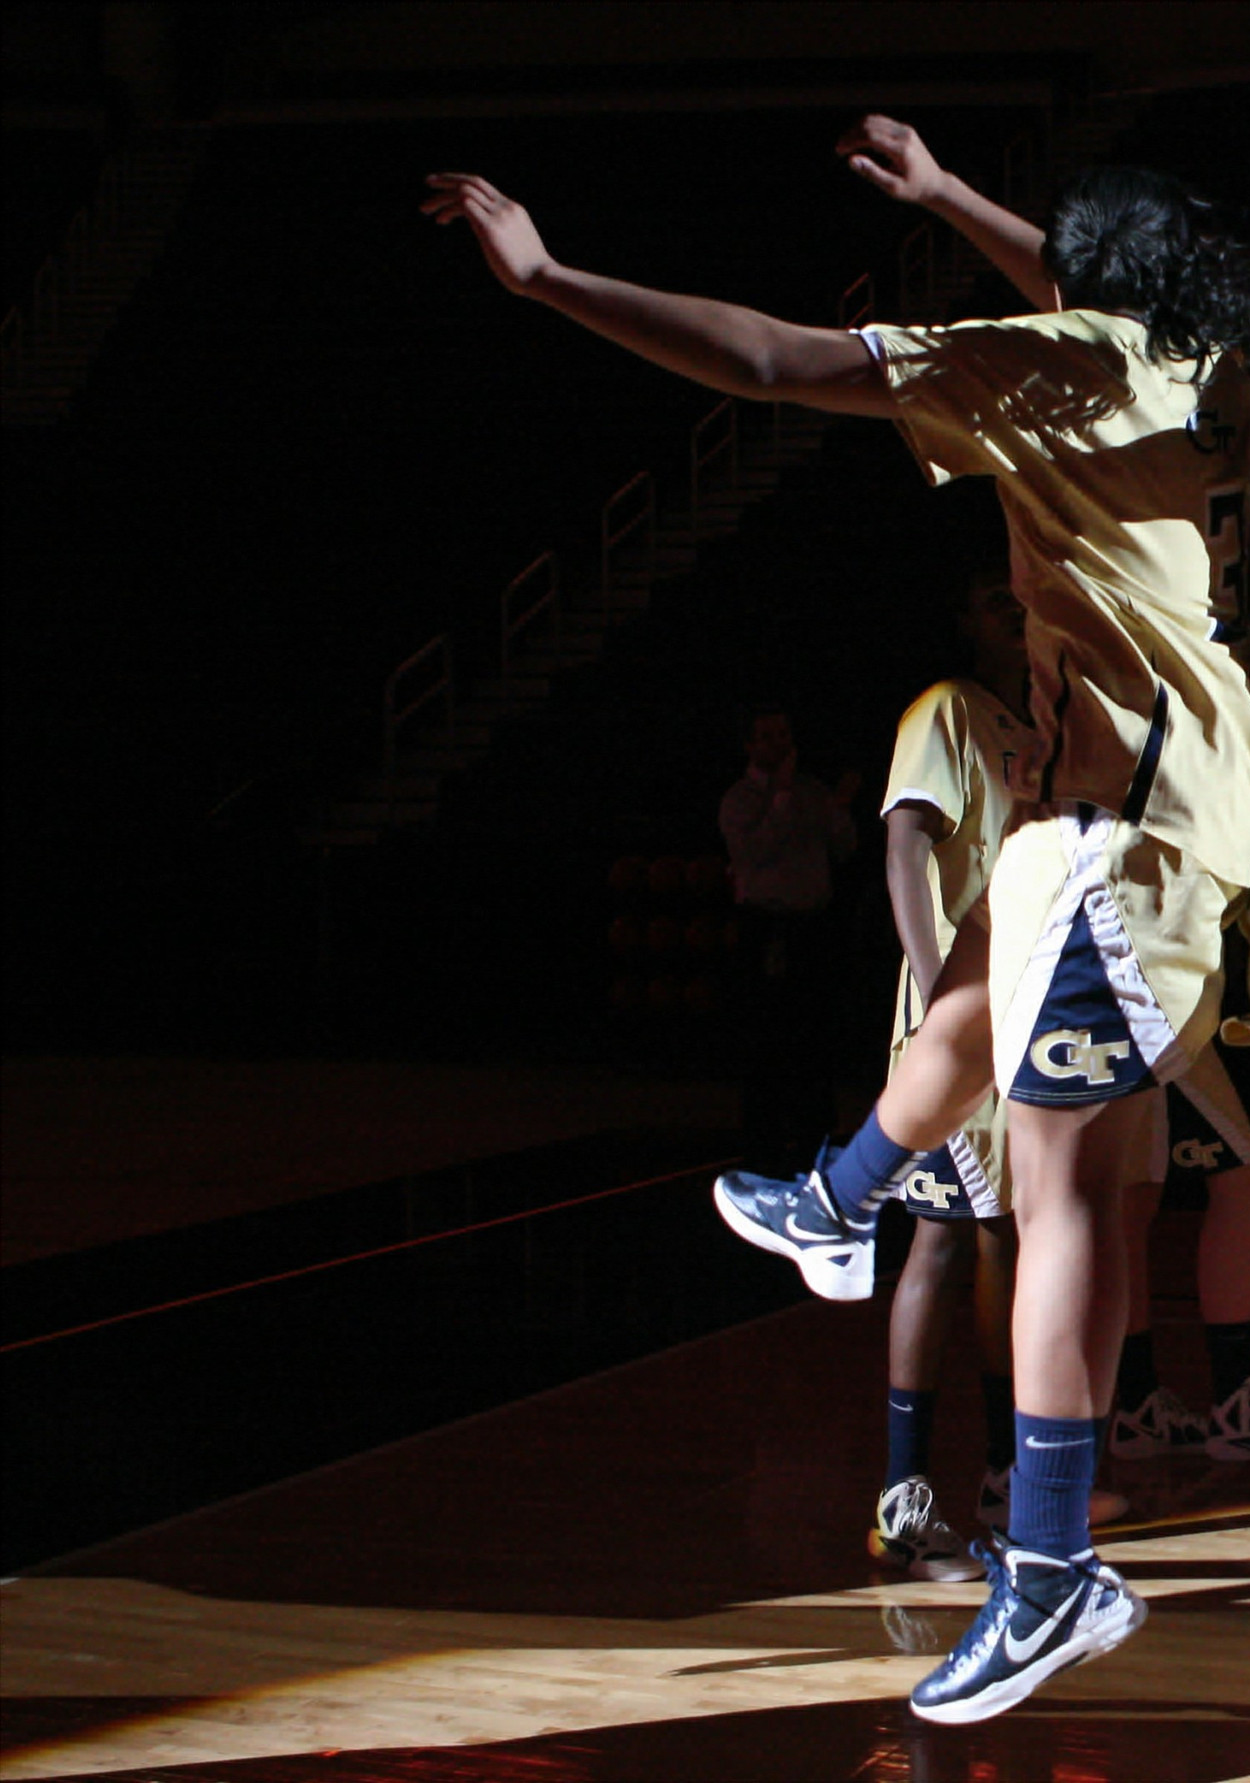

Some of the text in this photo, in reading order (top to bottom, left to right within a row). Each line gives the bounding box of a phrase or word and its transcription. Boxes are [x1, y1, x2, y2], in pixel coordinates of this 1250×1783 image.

[1030, 1029, 1130, 1085] GT
[1172, 1137, 1225, 1169] GT
[906, 1169, 960, 1208] GT
